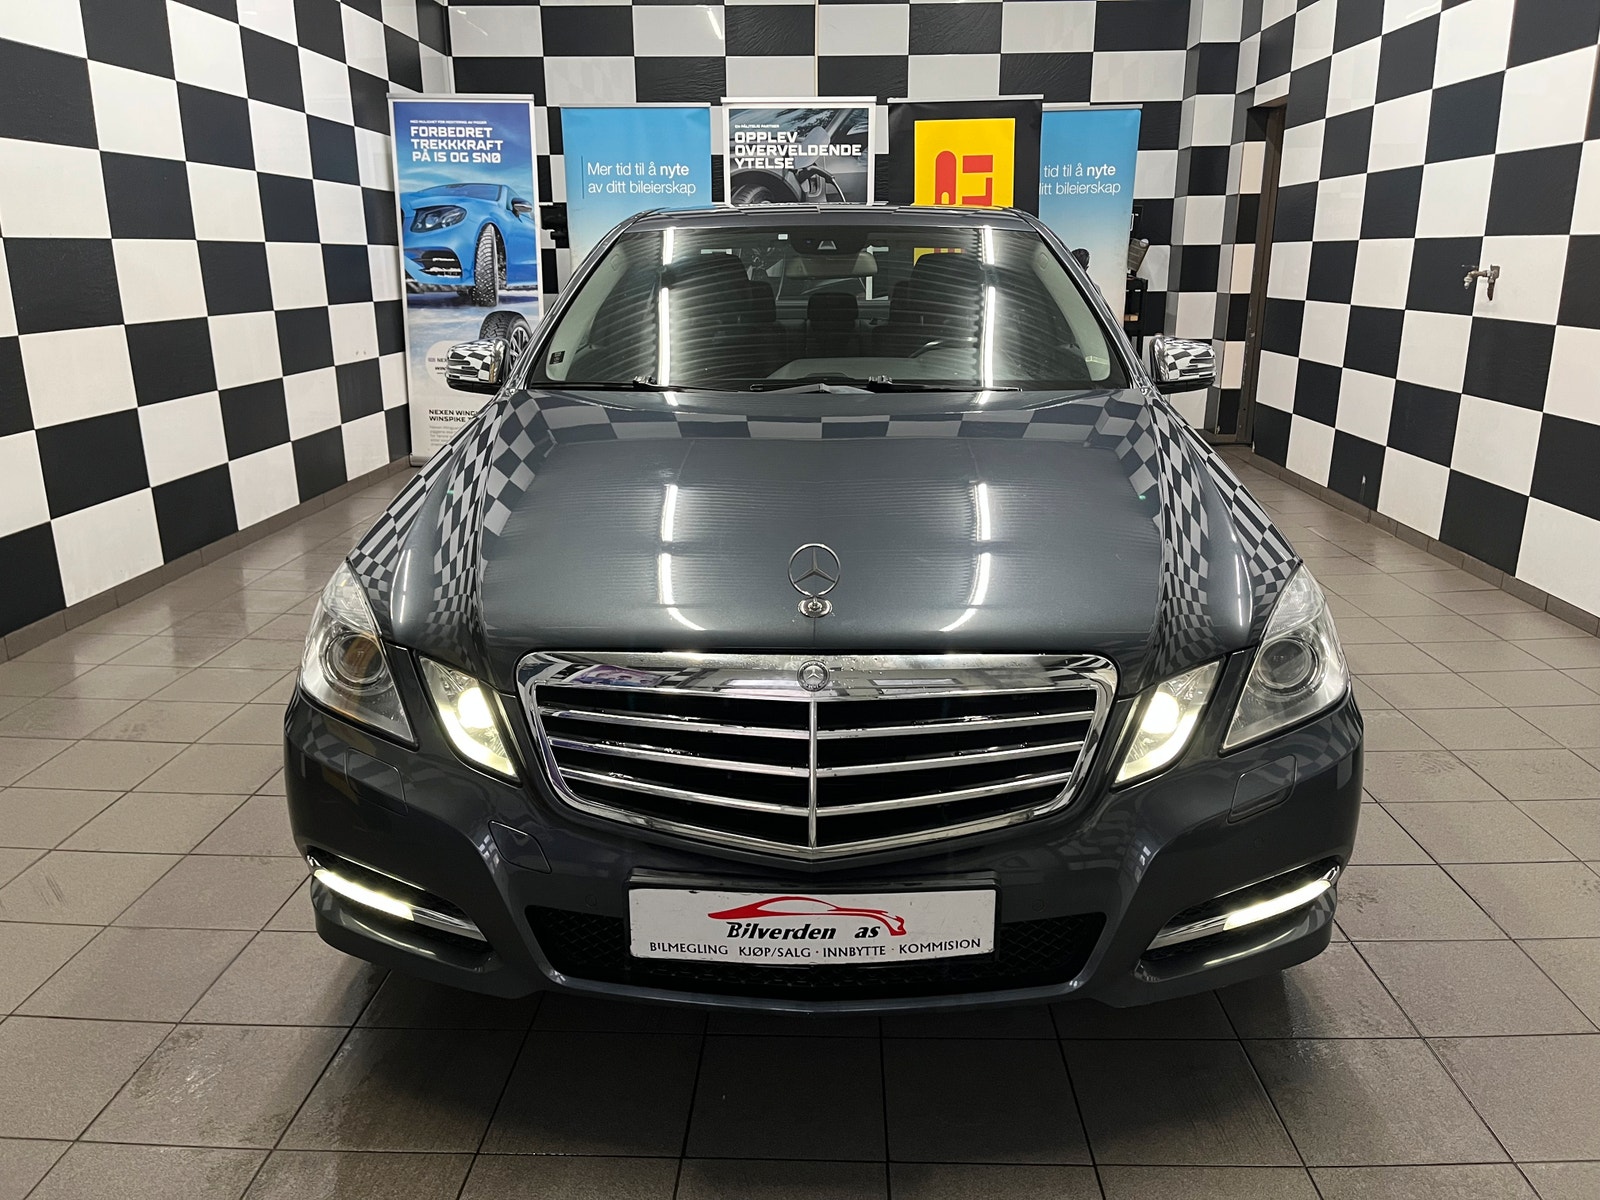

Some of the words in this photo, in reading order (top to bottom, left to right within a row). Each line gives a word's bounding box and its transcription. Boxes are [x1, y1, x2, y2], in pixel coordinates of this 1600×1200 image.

[410, 126, 493, 138] FORBEDRET
[734, 131, 798, 143] OPPLEV
[410, 138, 503, 151] TREKKKRAFT
[734, 144, 862, 156] OVERVELDENDE
[412, 149, 431, 162] PÅ
[434, 152, 447, 162] IS
[450, 152, 470, 163] OG
[472, 152, 501, 164] SNØ
[734, 157, 795, 169] YTELSE
[587, 162, 612, 176] Mer
[616, 162, 632, 176] tid
[634, 162, 645, 176] til
[648, 161, 657, 176] å
[660, 163, 690, 179] nyte
[1043, 164, 1059, 178] tid
[1062, 164, 1072, 177] til
[1075, 162, 1083, 177] å
[1086, 163, 1116, 179] nyte
[588, 183, 603, 193] av
[606, 180, 626, 194] ditt
[629, 180, 696, 196] bileierskap
[1055, 181, 1121, 196] bileierskap
[428, 415, 466, 423] WINSPIKE
[726, 921, 837, 940] Bilverden
[854, 925, 881, 939] as
[649, 941, 728, 955] BILMEGLING
[739, 946, 811, 958] KJØP/SALG
[823, 945, 886, 958] INNBYTTE
[899, 938, 981, 954] KOMMISION
